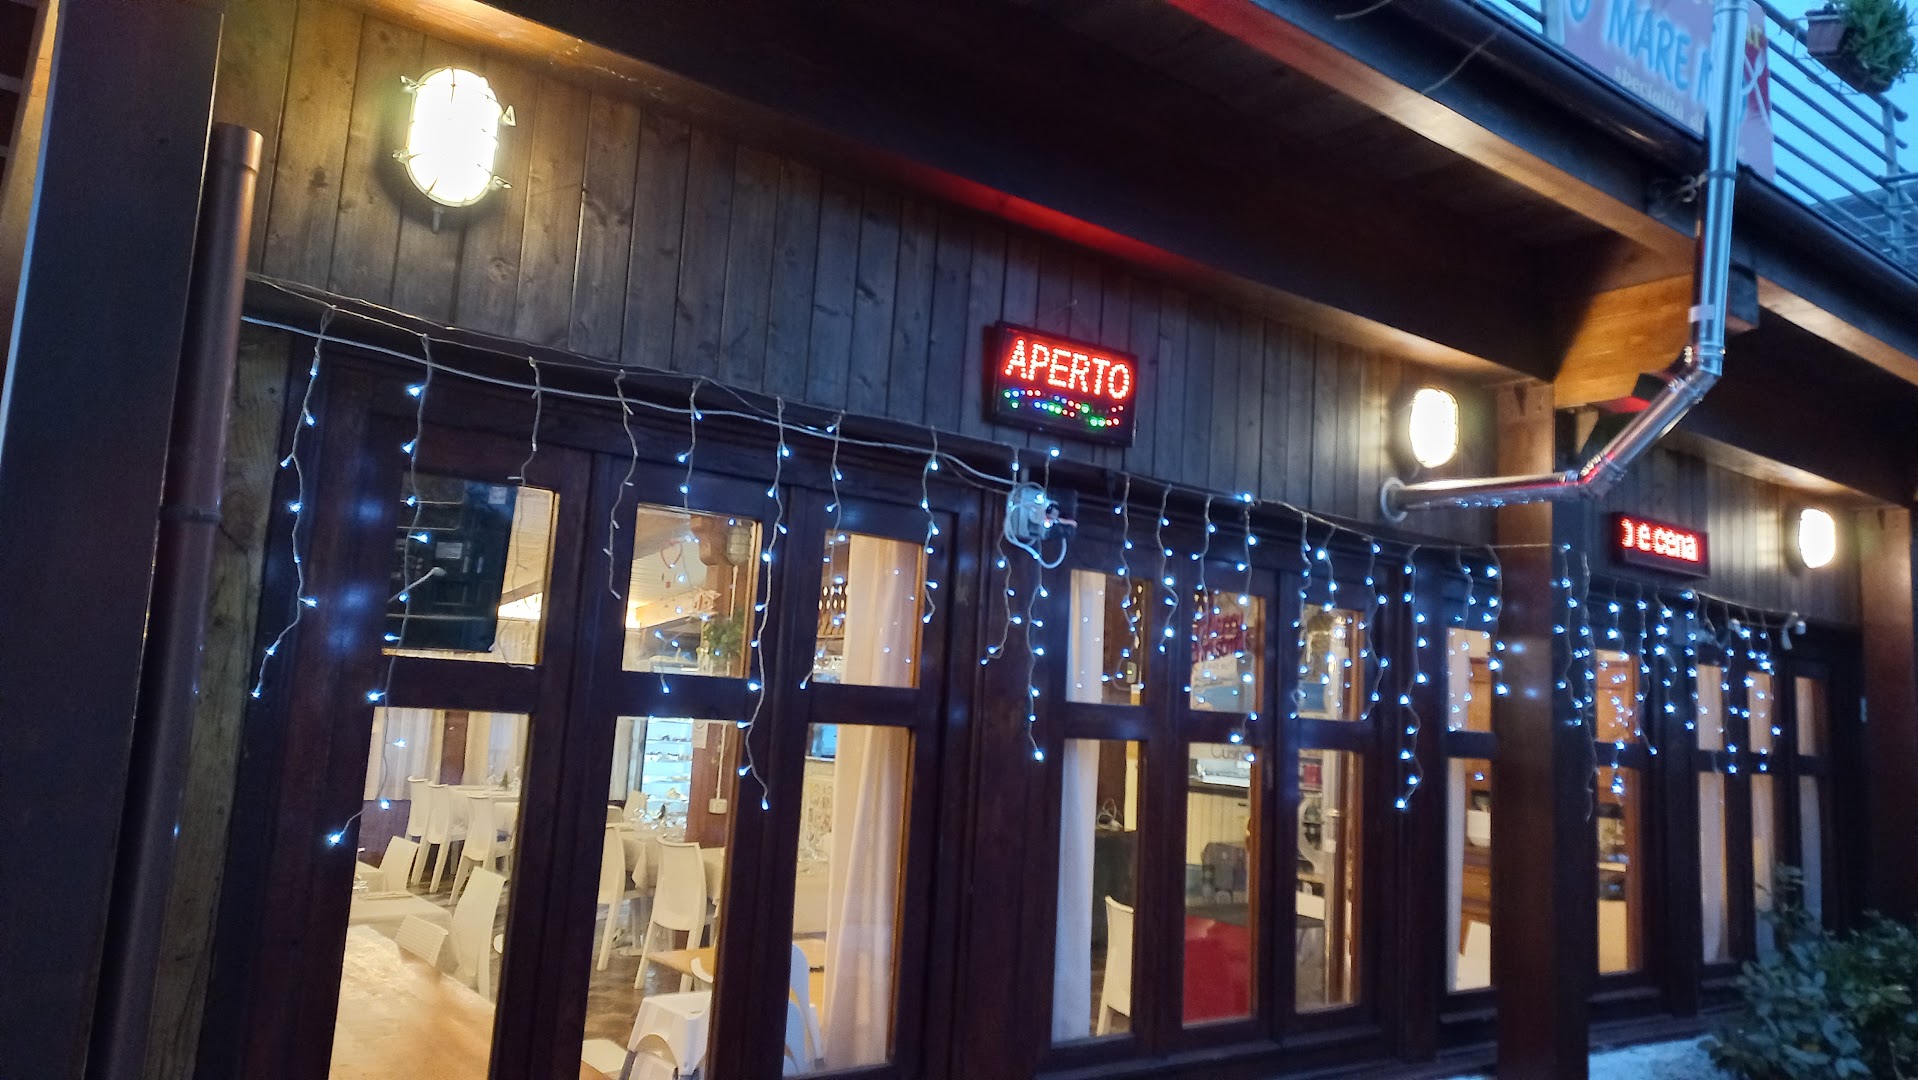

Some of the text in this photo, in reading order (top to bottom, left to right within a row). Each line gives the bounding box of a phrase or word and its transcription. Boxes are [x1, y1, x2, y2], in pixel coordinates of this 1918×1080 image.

[1607, 0, 1690, 91] MARE
[1004, 338, 1130, 399] APERTO
[1637, 522, 1652, 552] e
[1653, 526, 1698, 562] cena
